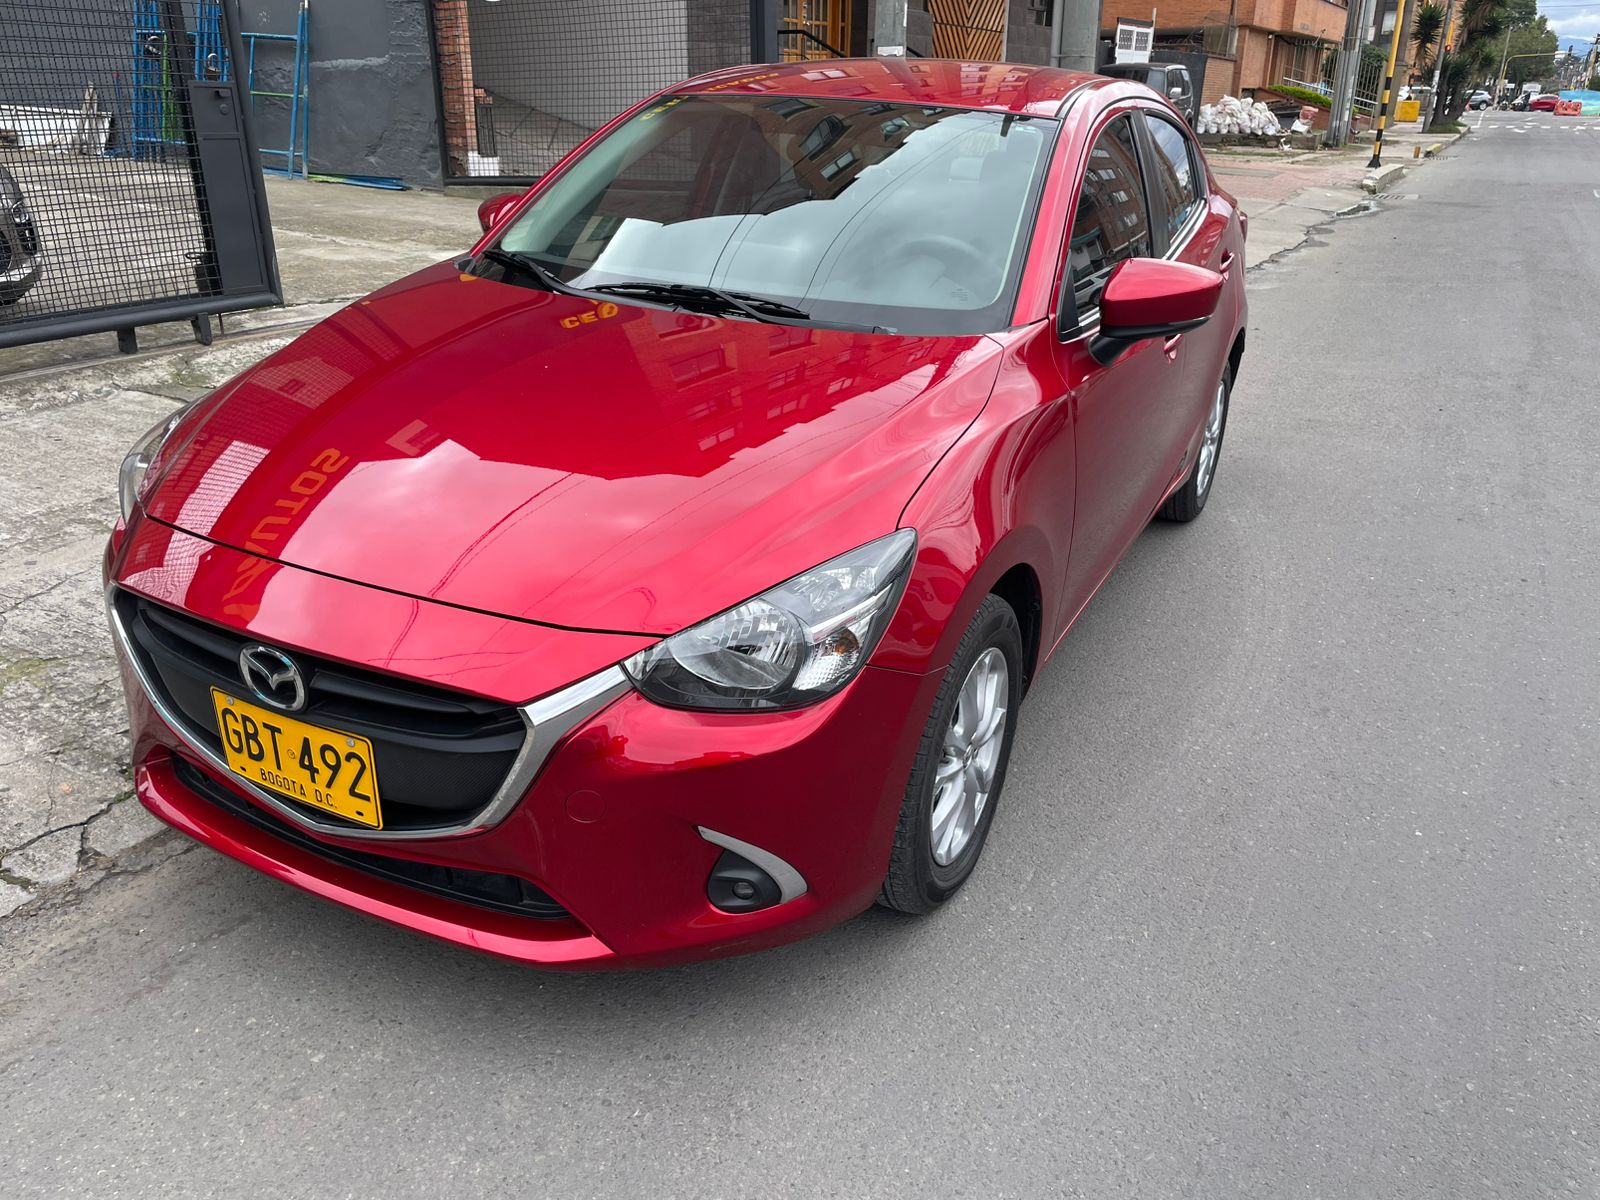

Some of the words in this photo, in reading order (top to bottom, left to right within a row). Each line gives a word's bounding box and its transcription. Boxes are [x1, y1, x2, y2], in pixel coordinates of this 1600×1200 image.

[221, 707, 282, 771] GBT
[299, 736, 371, 802] 492
[260, 767, 307, 797] BOGOTA
